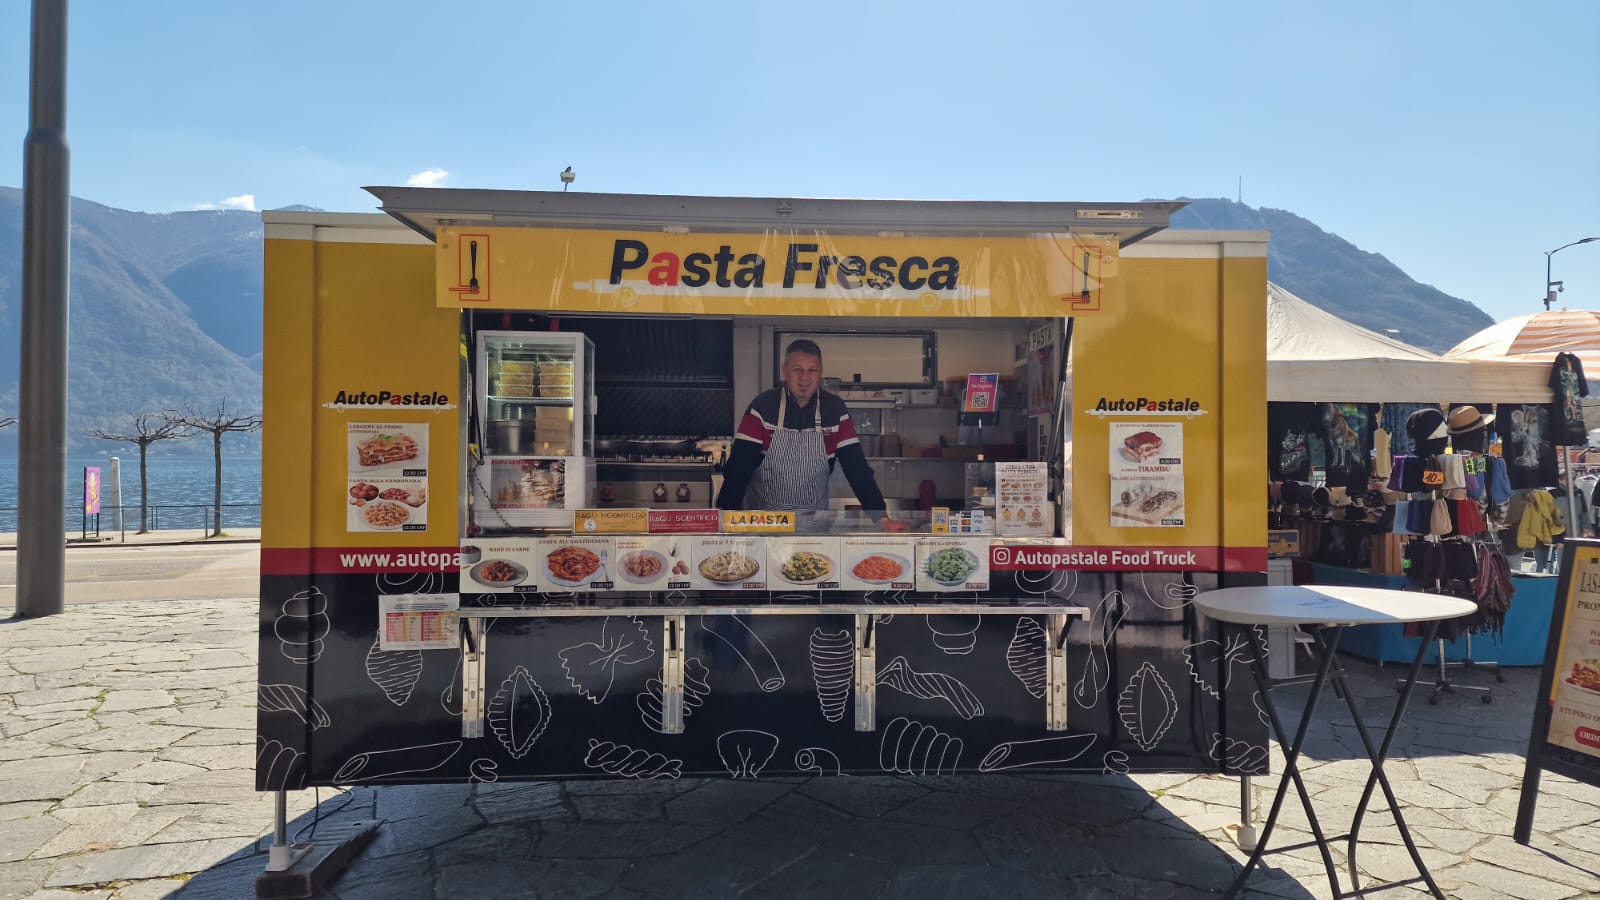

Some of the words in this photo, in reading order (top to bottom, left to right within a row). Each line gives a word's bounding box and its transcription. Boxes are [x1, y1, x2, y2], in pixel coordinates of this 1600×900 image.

[609, 239, 766, 288] Pasta
[783, 243, 958, 291] Fresca
[334, 390, 449, 405] AutoPastale
[1096, 397, 1200, 411] AutoPastale
[730, 514, 746, 525] LA
[750, 514, 789, 525] PASTA
[1014, 550, 1108, 568] Autopastale
[1111, 550, 1149, 566] Food
[1152, 550, 1197, 566] Truck
